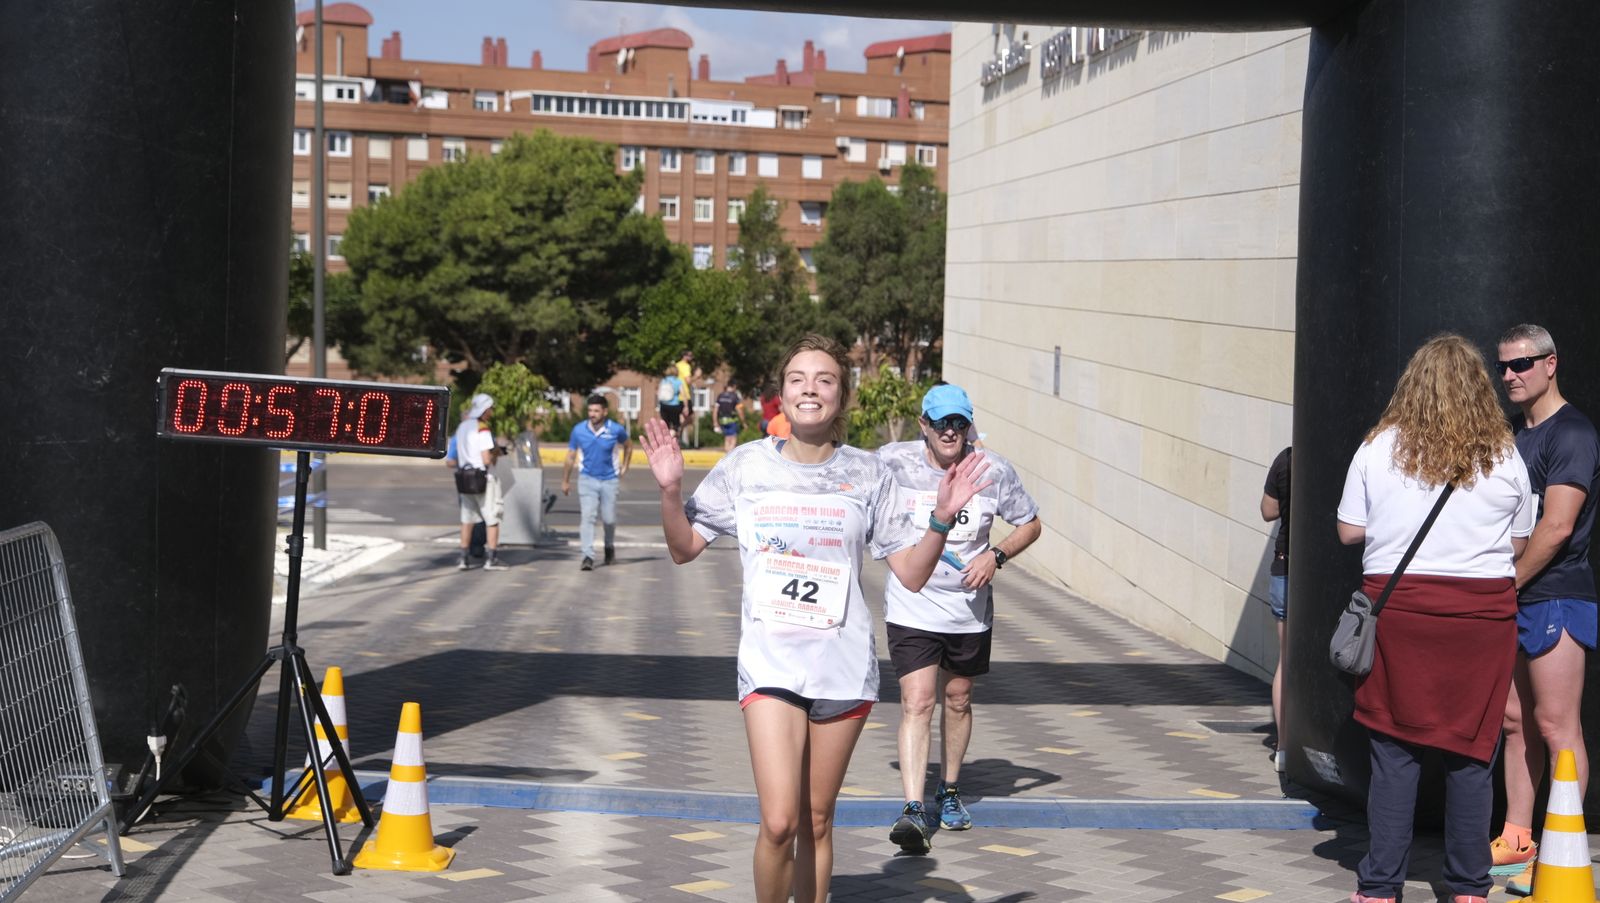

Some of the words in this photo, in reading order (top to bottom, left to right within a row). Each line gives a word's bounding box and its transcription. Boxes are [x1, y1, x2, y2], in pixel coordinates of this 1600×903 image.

[801, 507, 817, 516] SIN
[820, 508, 846, 518] HUMO
[781, 578, 820, 604] 42
